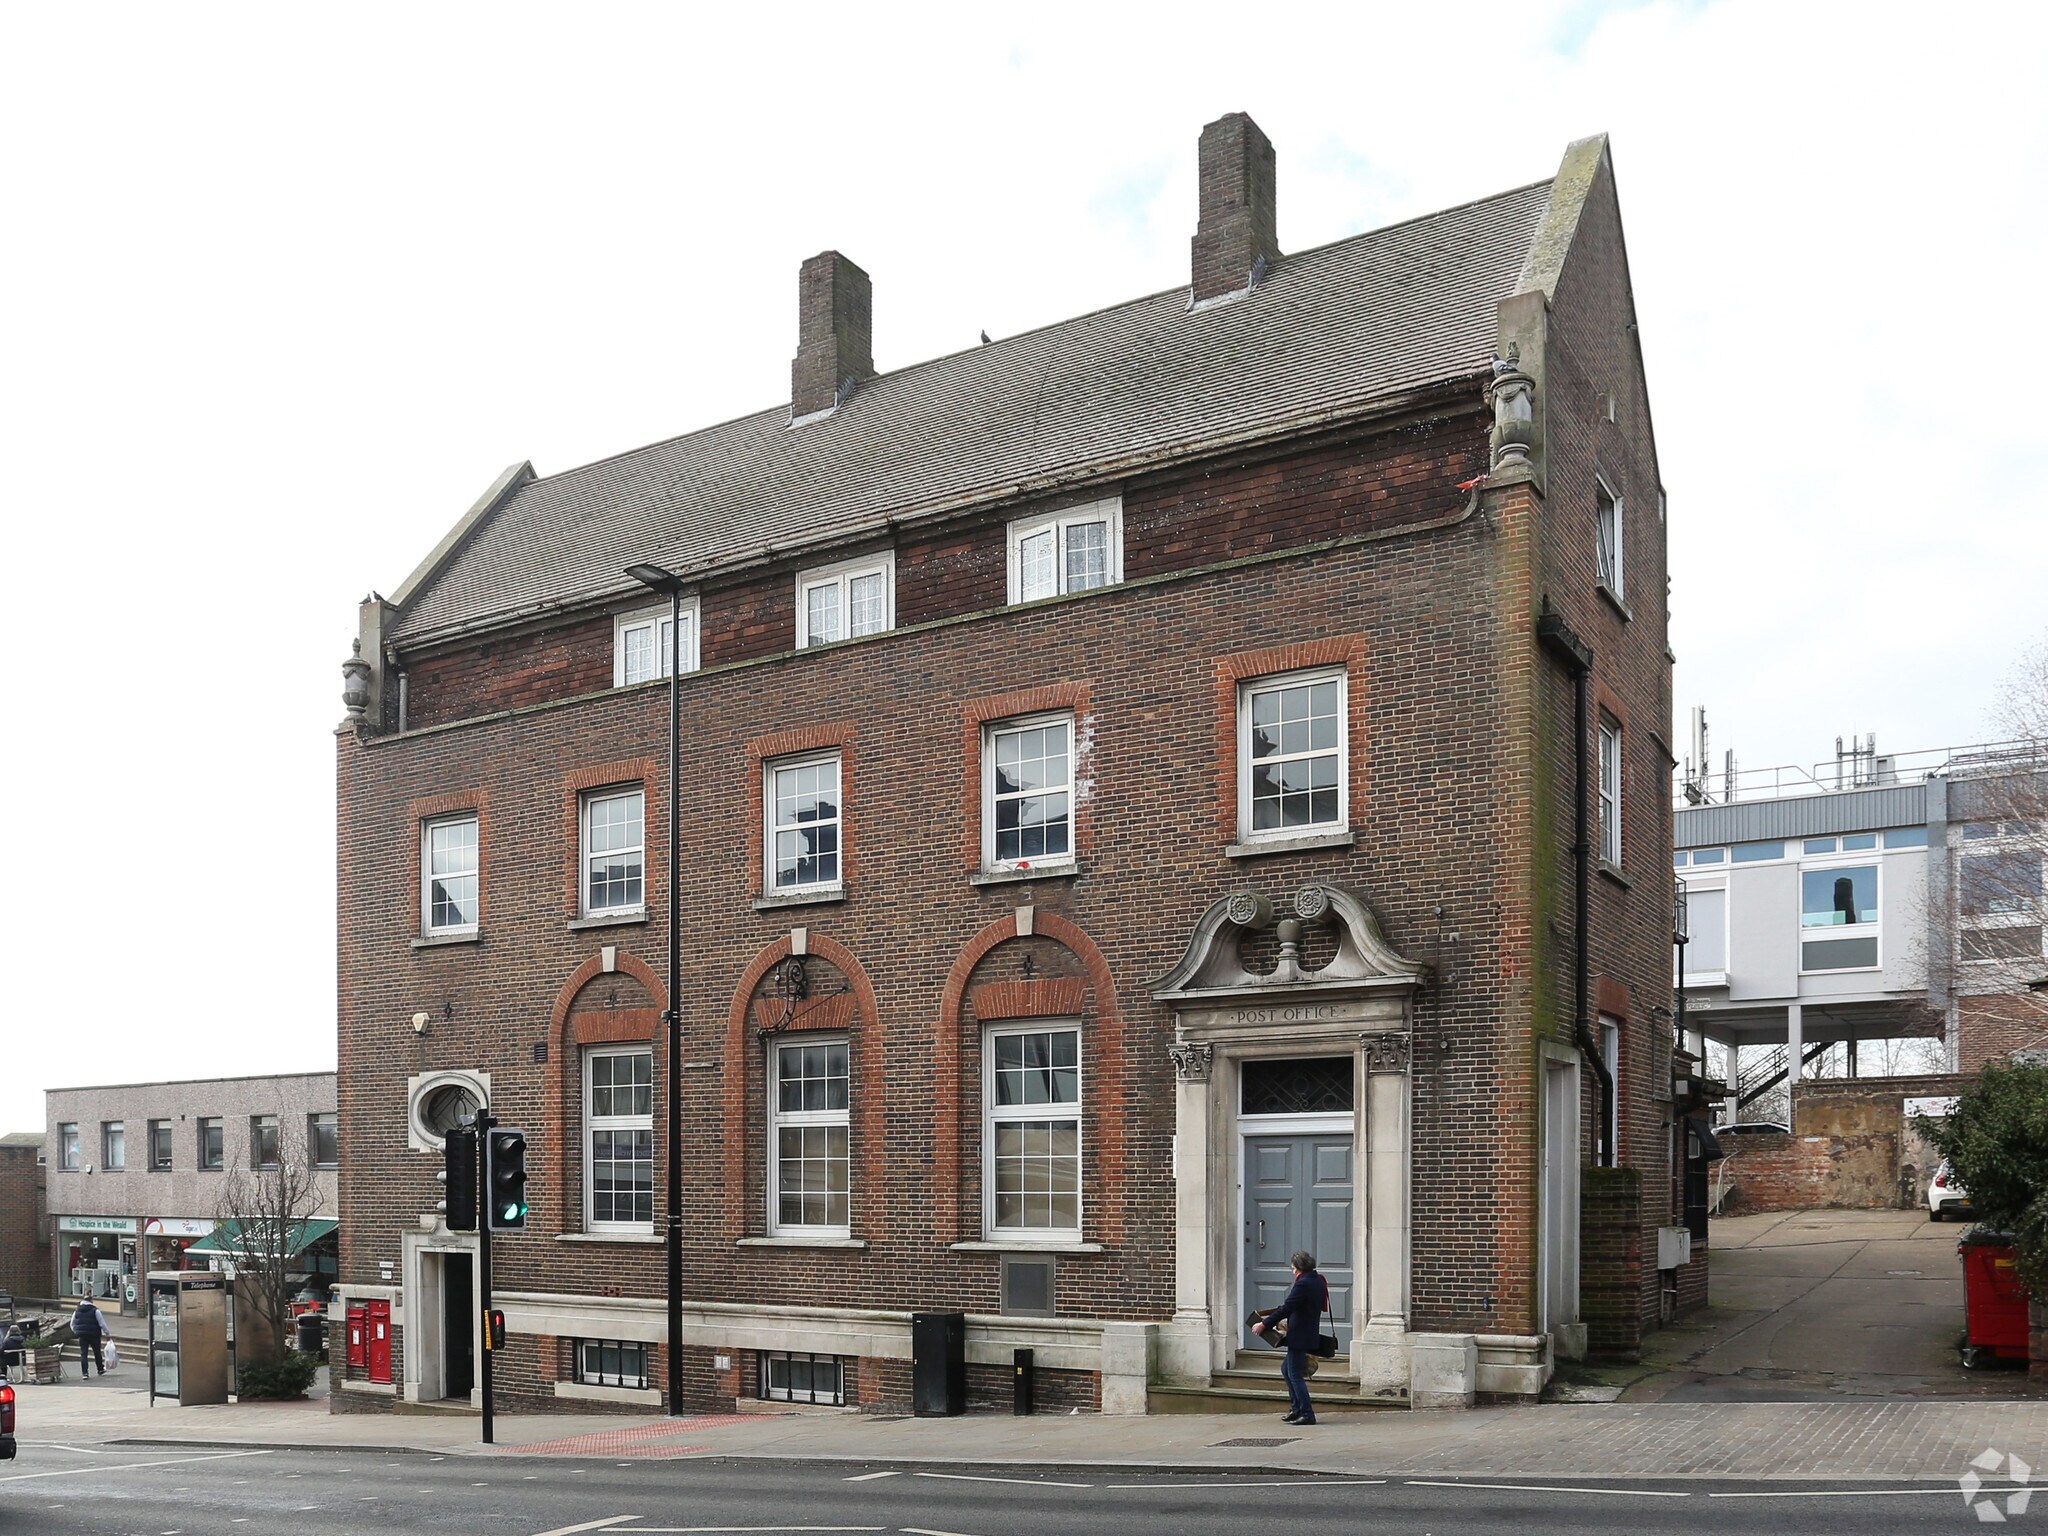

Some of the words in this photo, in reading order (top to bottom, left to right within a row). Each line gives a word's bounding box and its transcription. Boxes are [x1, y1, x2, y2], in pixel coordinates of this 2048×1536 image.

[1237, 1009, 1276, 1023] POST
[1284, 1006, 1339, 1021] OFFICE
[78, 1220, 96, 1228] Hospice
[97, 1220, 102, 1228] in
[103, 1220, 111, 1228] the
